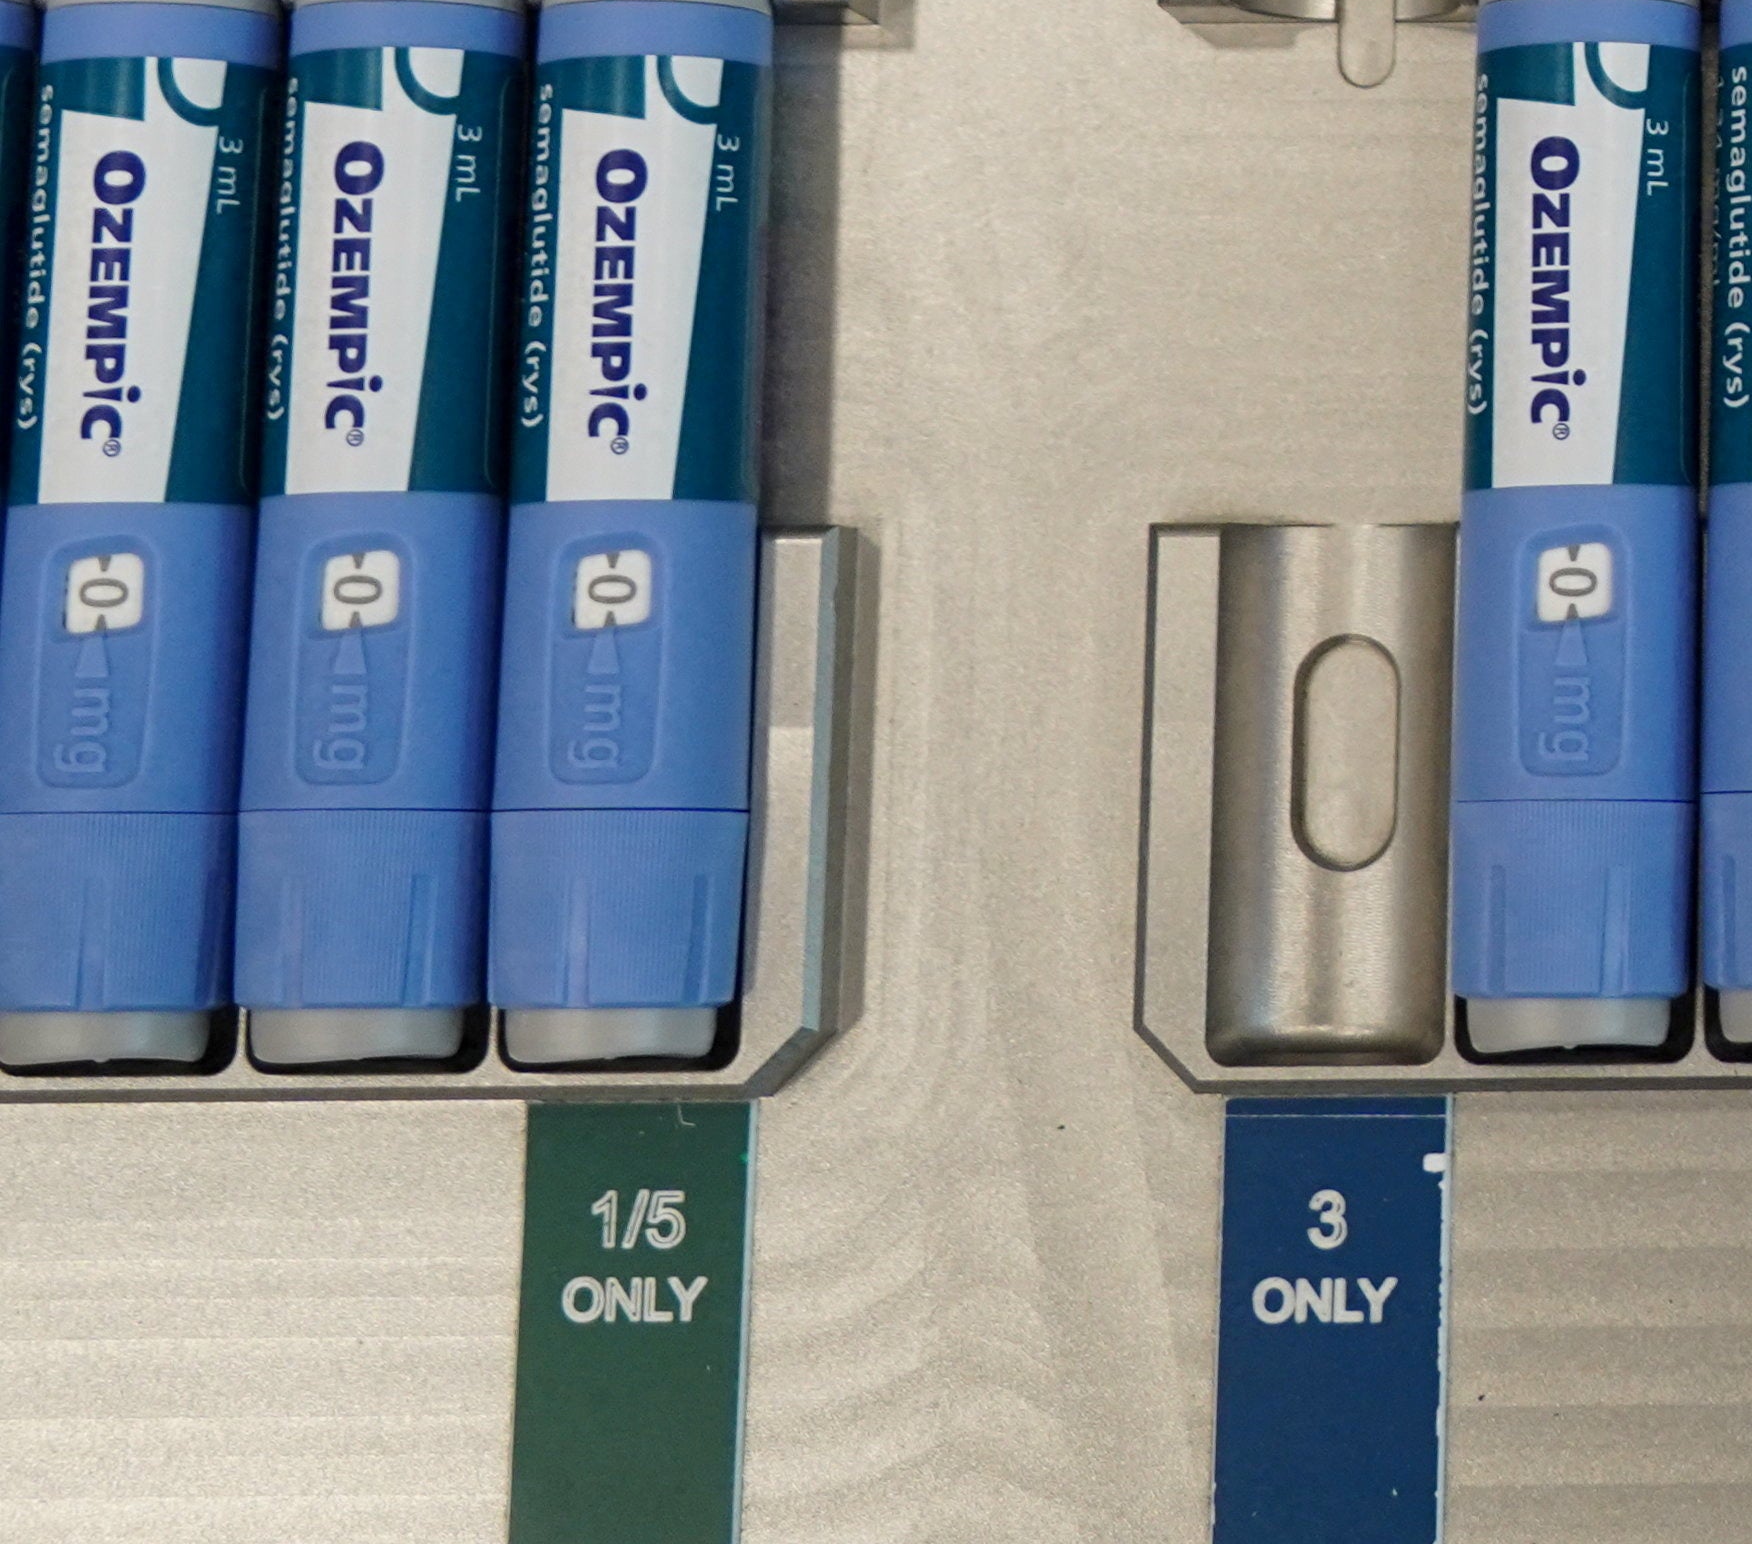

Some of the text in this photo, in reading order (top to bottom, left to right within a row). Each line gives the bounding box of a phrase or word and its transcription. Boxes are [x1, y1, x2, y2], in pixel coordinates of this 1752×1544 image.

[218, 138, 241, 212] 3 mL
[457, 126, 481, 200] 3 mL
[717, 136, 738, 210] 3 mL
[1647, 119, 1668, 195] 3 mL
[276, 78, 298, 320] semaglutide
[18, 85, 53, 428] semaglutide (rys)
[522, 84, 552, 427] semaglutide (rys)
[1724, 67, 1751, 407] semaglutide (rys)
[1469, 330, 1488, 417] (rys)
[79, 578, 128, 607] 0
[333, 575, 382, 604] 0
[588, 575, 637, 604] 0
[1549, 568, 1597, 597] 0
[55, 687, 109, 773] mg
[313, 685, 366, 770] mg
[567, 685, 620, 770] mg
[1538, 679, 1591, 762] mg
[591, 1189, 687, 1249] 1/5
[1307, 1189, 1348, 1250] 3
[562, 1276, 708, 1323] ONLY
[1252, 1276, 1398, 1325] ONLY
